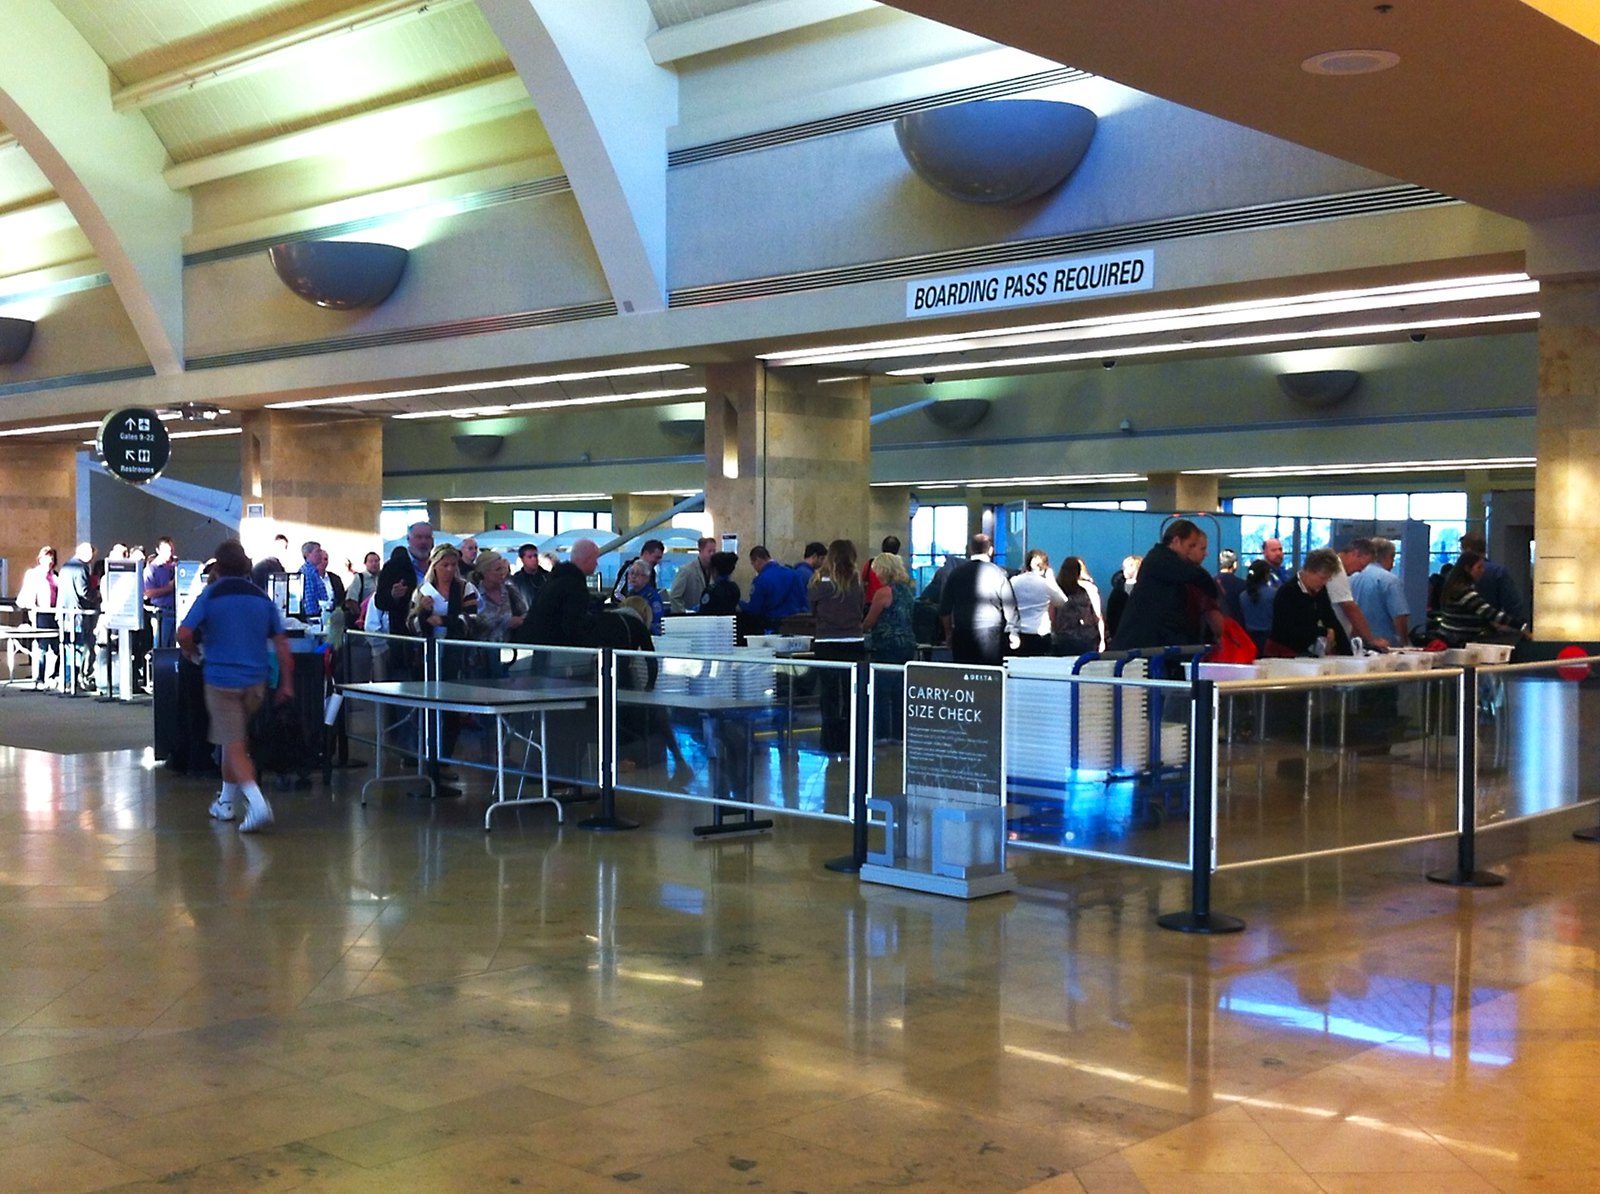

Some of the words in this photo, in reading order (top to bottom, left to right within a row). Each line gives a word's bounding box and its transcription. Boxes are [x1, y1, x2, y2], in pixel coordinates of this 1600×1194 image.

[914, 278, 999, 310] BOARDING
[1003, 271, 1048, 299] PASS
[1053, 259, 1144, 293] REQUIRED
[120, 432, 138, 440] Gates
[120, 465, 155, 473] Restrooms
[908, 686, 975, 703] CARRY-ON
[908, 704, 934, 719] SIZE
[938, 706, 982, 723] CHECK
